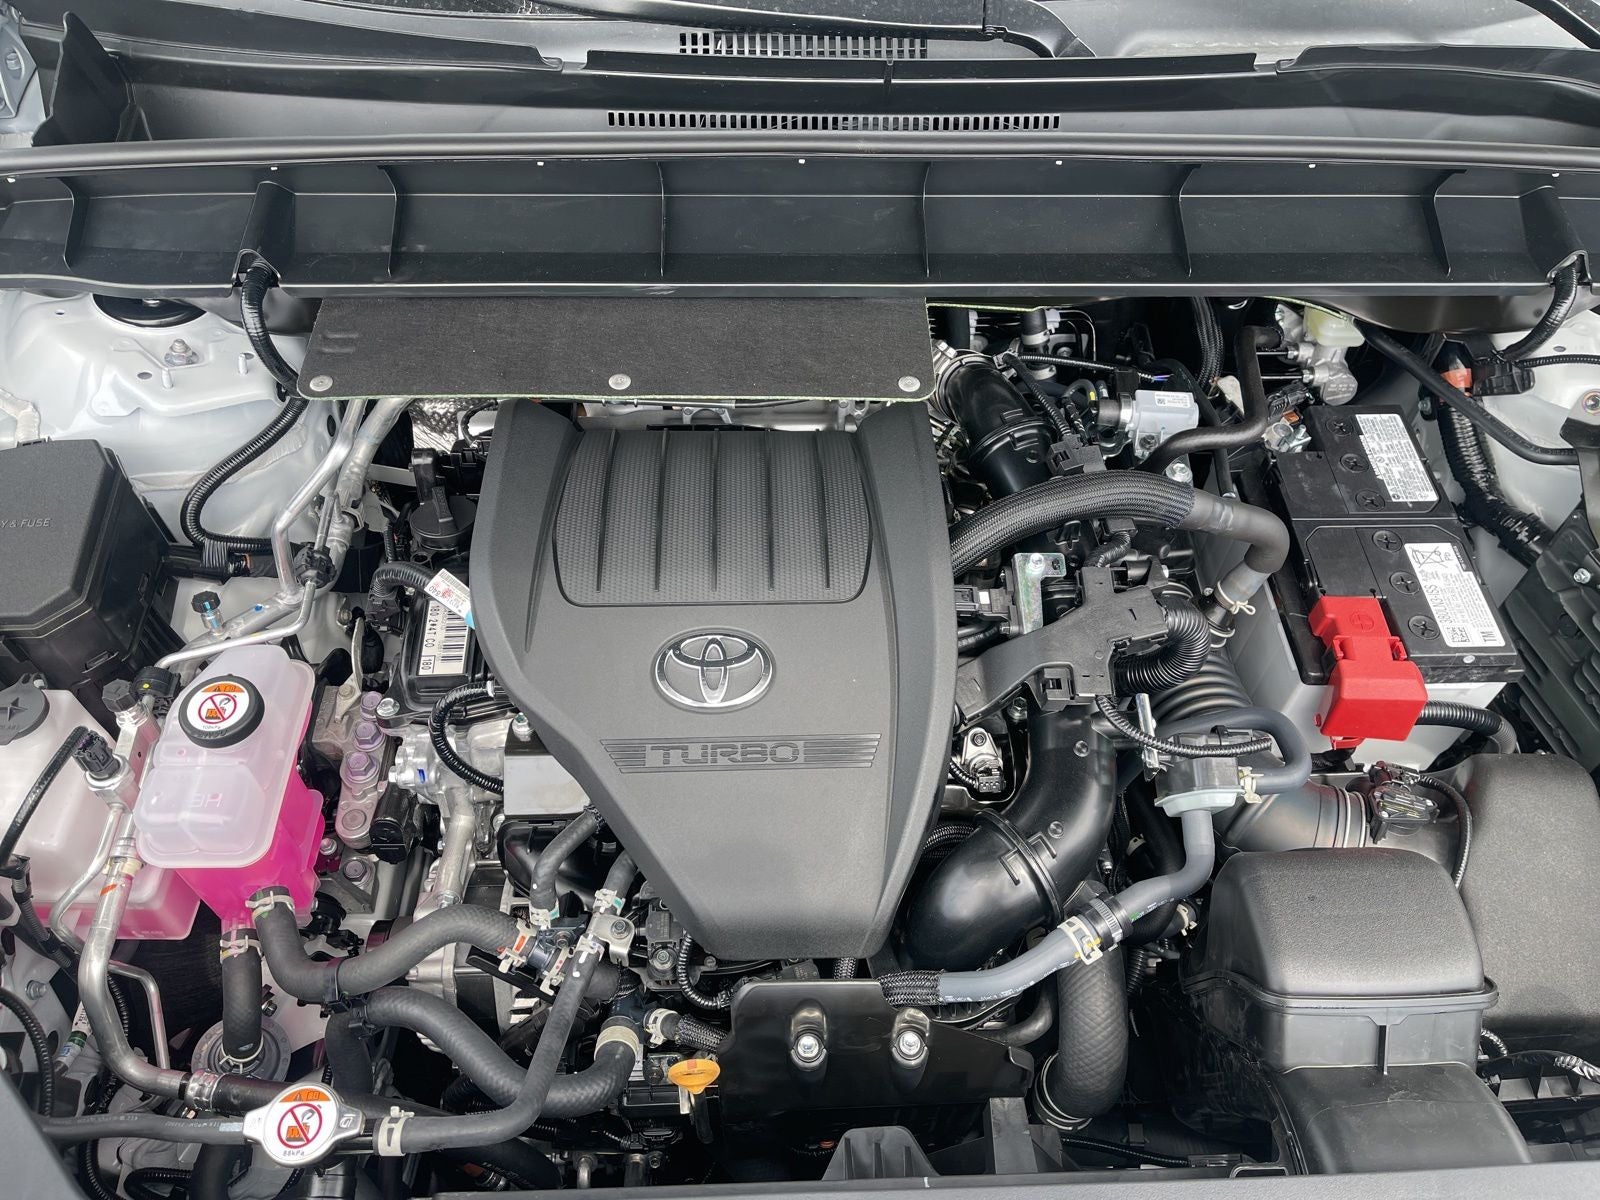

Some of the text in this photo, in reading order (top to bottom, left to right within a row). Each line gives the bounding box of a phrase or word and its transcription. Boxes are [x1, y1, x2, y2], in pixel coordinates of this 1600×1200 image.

[20, 518, 51, 528] FUSE
[1480, 631, 1497, 642] TM
[421, 659, 433, 671] 180
[650, 742, 800, 765] TURBO
